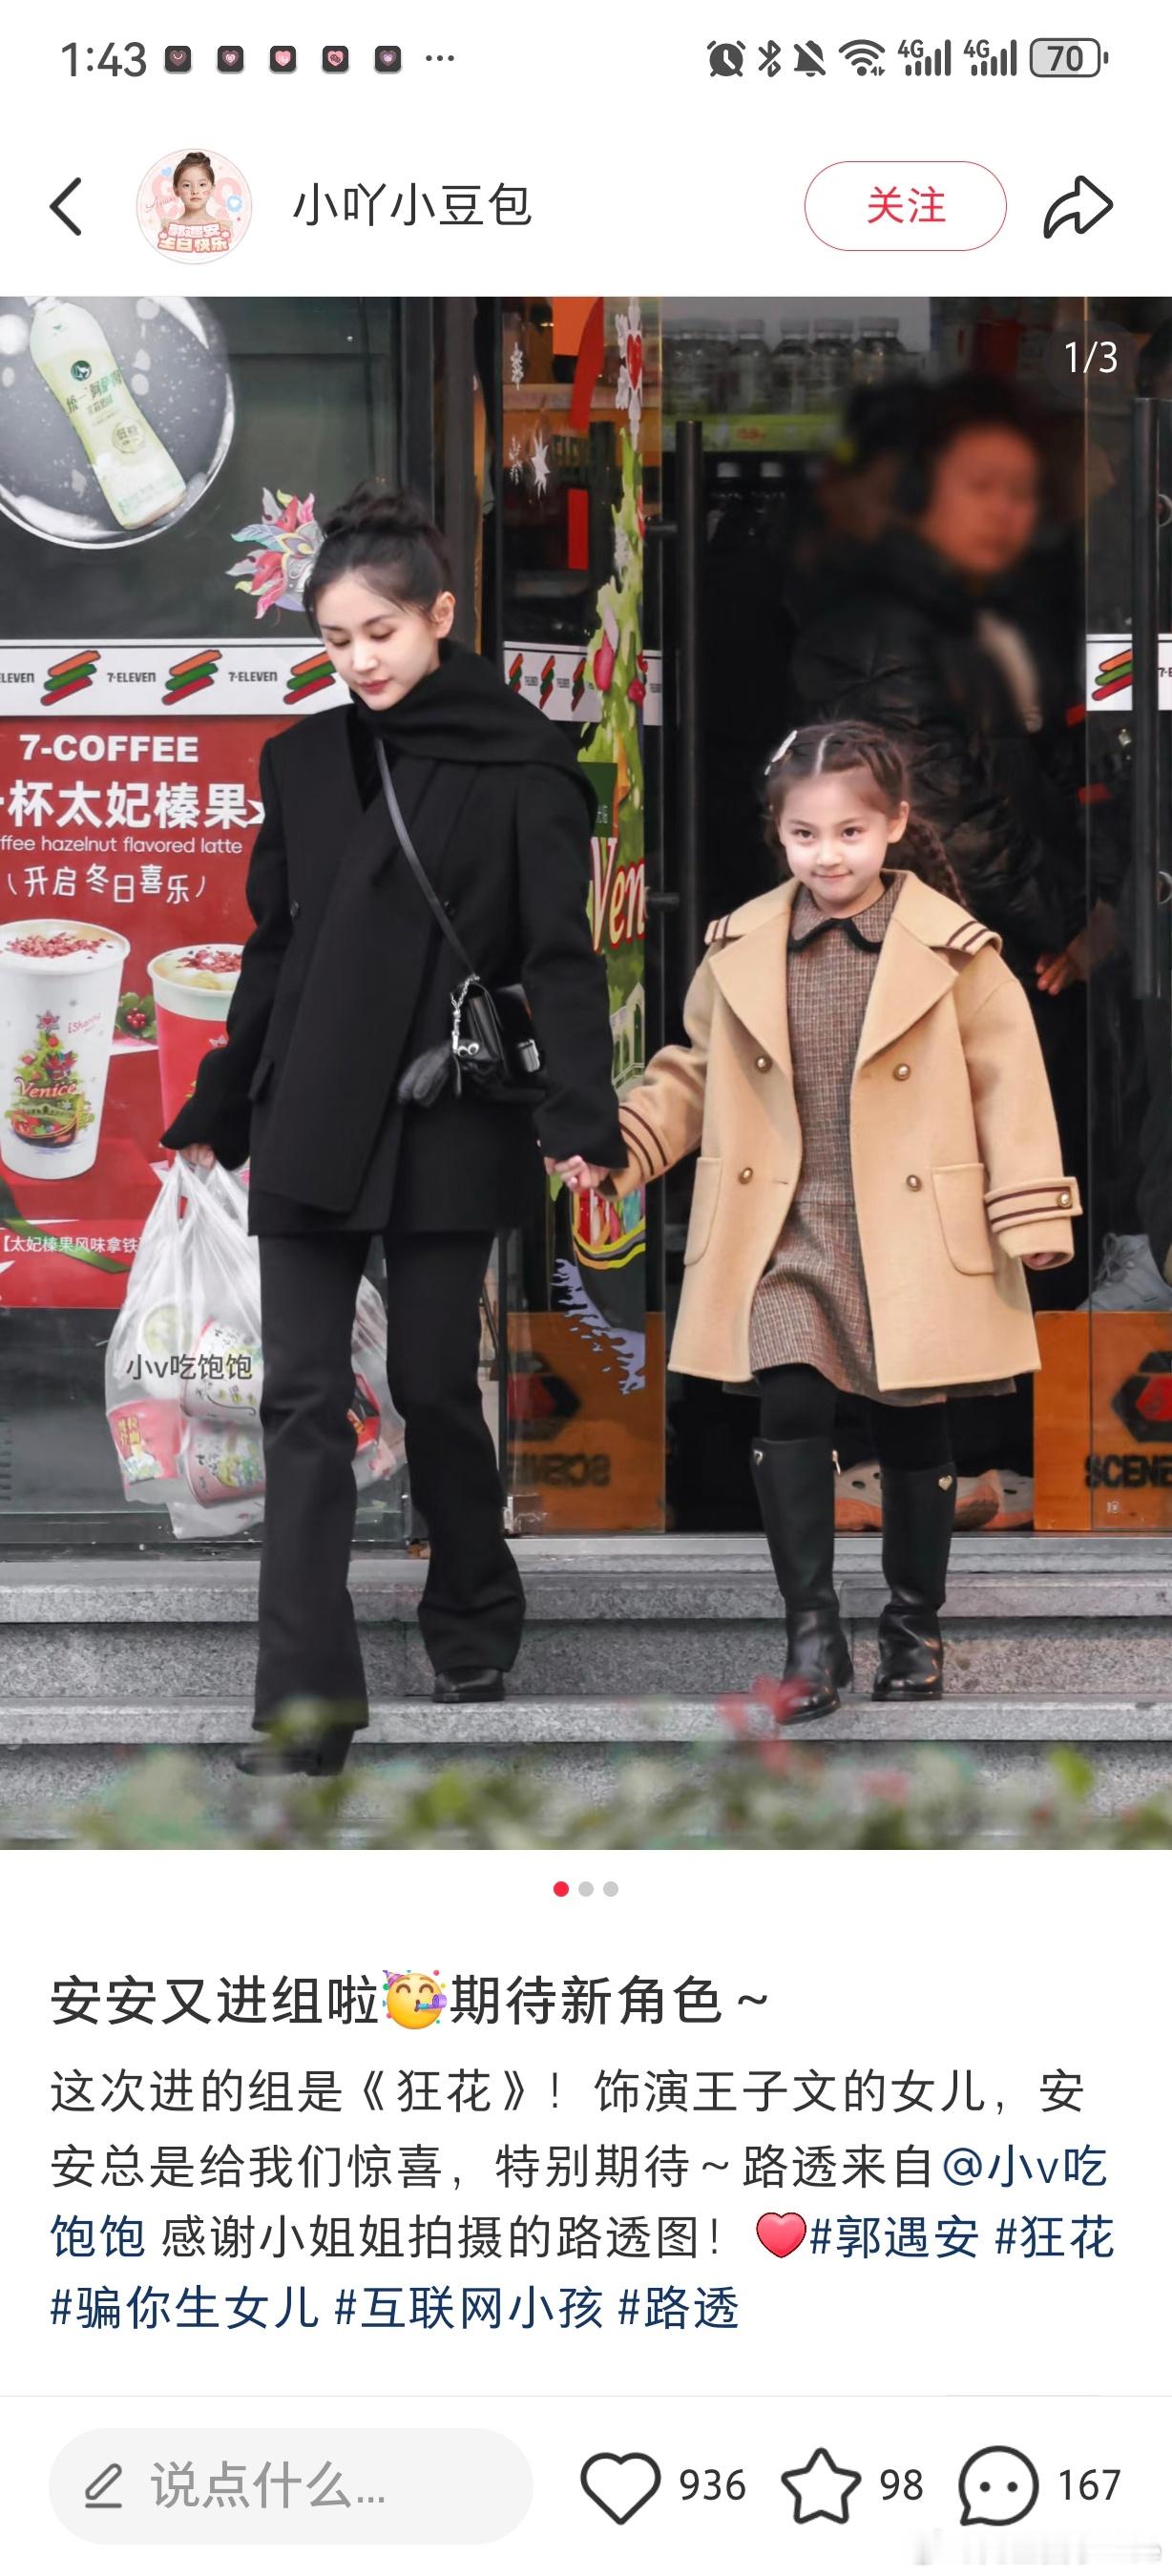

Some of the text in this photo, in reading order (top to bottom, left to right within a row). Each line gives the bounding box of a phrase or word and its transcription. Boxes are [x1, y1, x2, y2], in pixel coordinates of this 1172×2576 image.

[62, 42, 146, 77] 1:43
[898, 39, 924, 58] 4G
[964, 39, 990, 58] 4G
[1047, 45, 1083, 72] 70
[293, 182, 532, 226] 小吖小豆包
[868, 186, 946, 223] 关注
[19, 734, 199, 762] 7-COFFEE
[0, 779, 248, 829] 杯太妃榛果
[41, 835, 117, 852] hazelnut
[123, 835, 196, 854] flavored
[200, 837, 243, 854] latte
[14, 1076, 78, 1099] Venice
[52, 1974, 379, 2026] 安安又进组啦
[51, 2214, 145, 2257] 饱饱
[810, 2214, 978, 2258] #郭遇安
[995, 2214, 1114, 2258] #狂花
[51, 2285, 738, 2329] #骗你生女儿 #互联网小孩 #路透
[680, 2468, 746, 2502] 936
[880, 2468, 924, 2502] 98
[1059, 2468, 1121, 2502] 167
